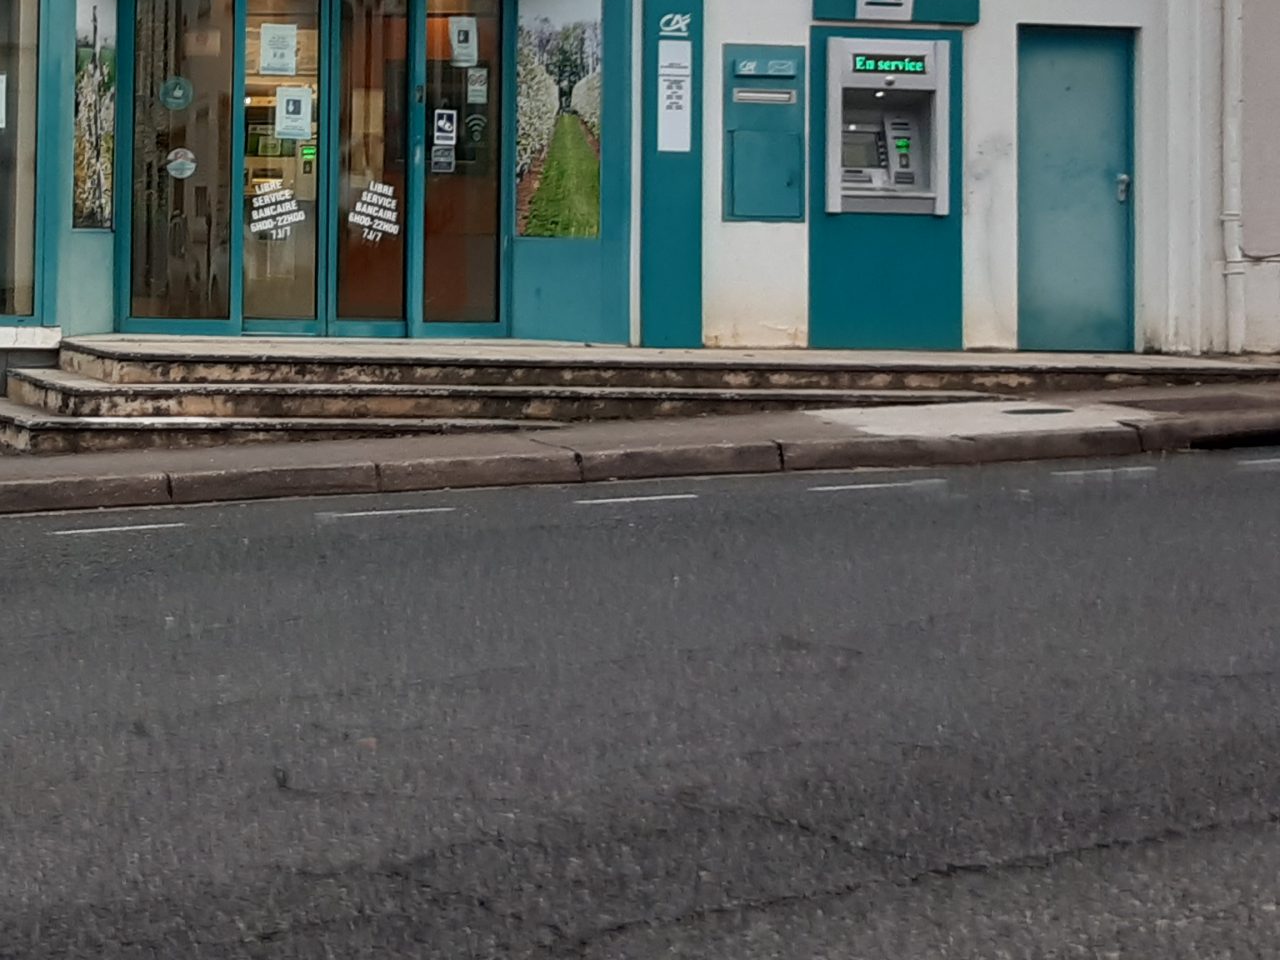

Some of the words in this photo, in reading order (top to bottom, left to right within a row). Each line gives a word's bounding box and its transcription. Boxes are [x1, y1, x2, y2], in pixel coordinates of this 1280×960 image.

[855, 56, 875, 70] En
[877, 58, 923, 71] service
[255, 180, 283, 194] LIBRE
[370, 180, 394, 196] LIBRE
[252, 189, 294, 207] SERVICE
[361, 190, 397, 209] SERVICE
[251, 200, 298, 220] BANCAIRE
[355, 201, 397, 222] BANCAIRE
